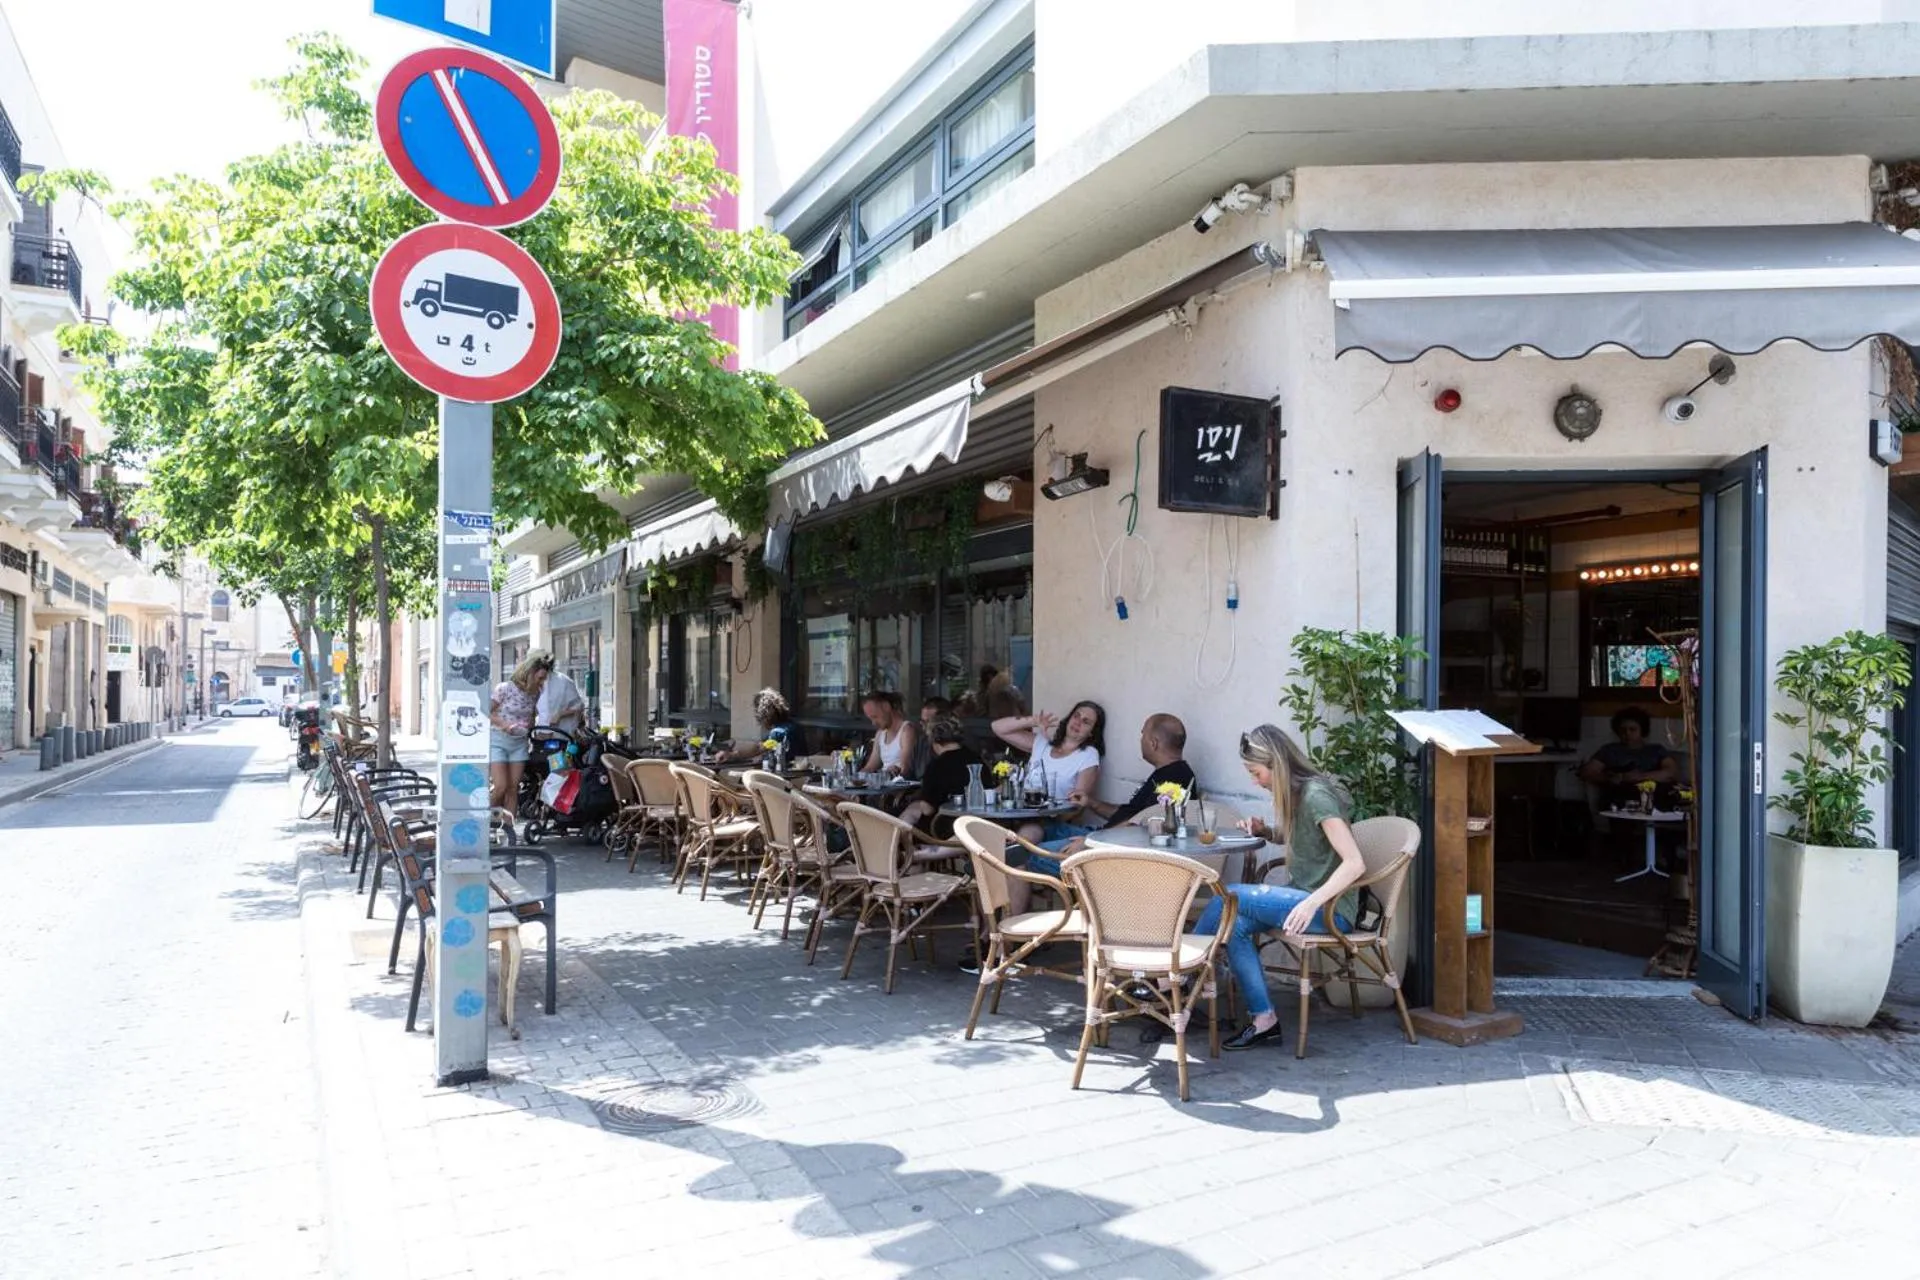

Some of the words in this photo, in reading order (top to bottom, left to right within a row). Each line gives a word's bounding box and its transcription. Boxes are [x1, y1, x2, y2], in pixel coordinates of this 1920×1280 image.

[695, 45, 712, 125] סטודיו
[437, 335, 450, 346] ט
[460, 334, 475, 352] 4
[485, 342, 491, 353] t
